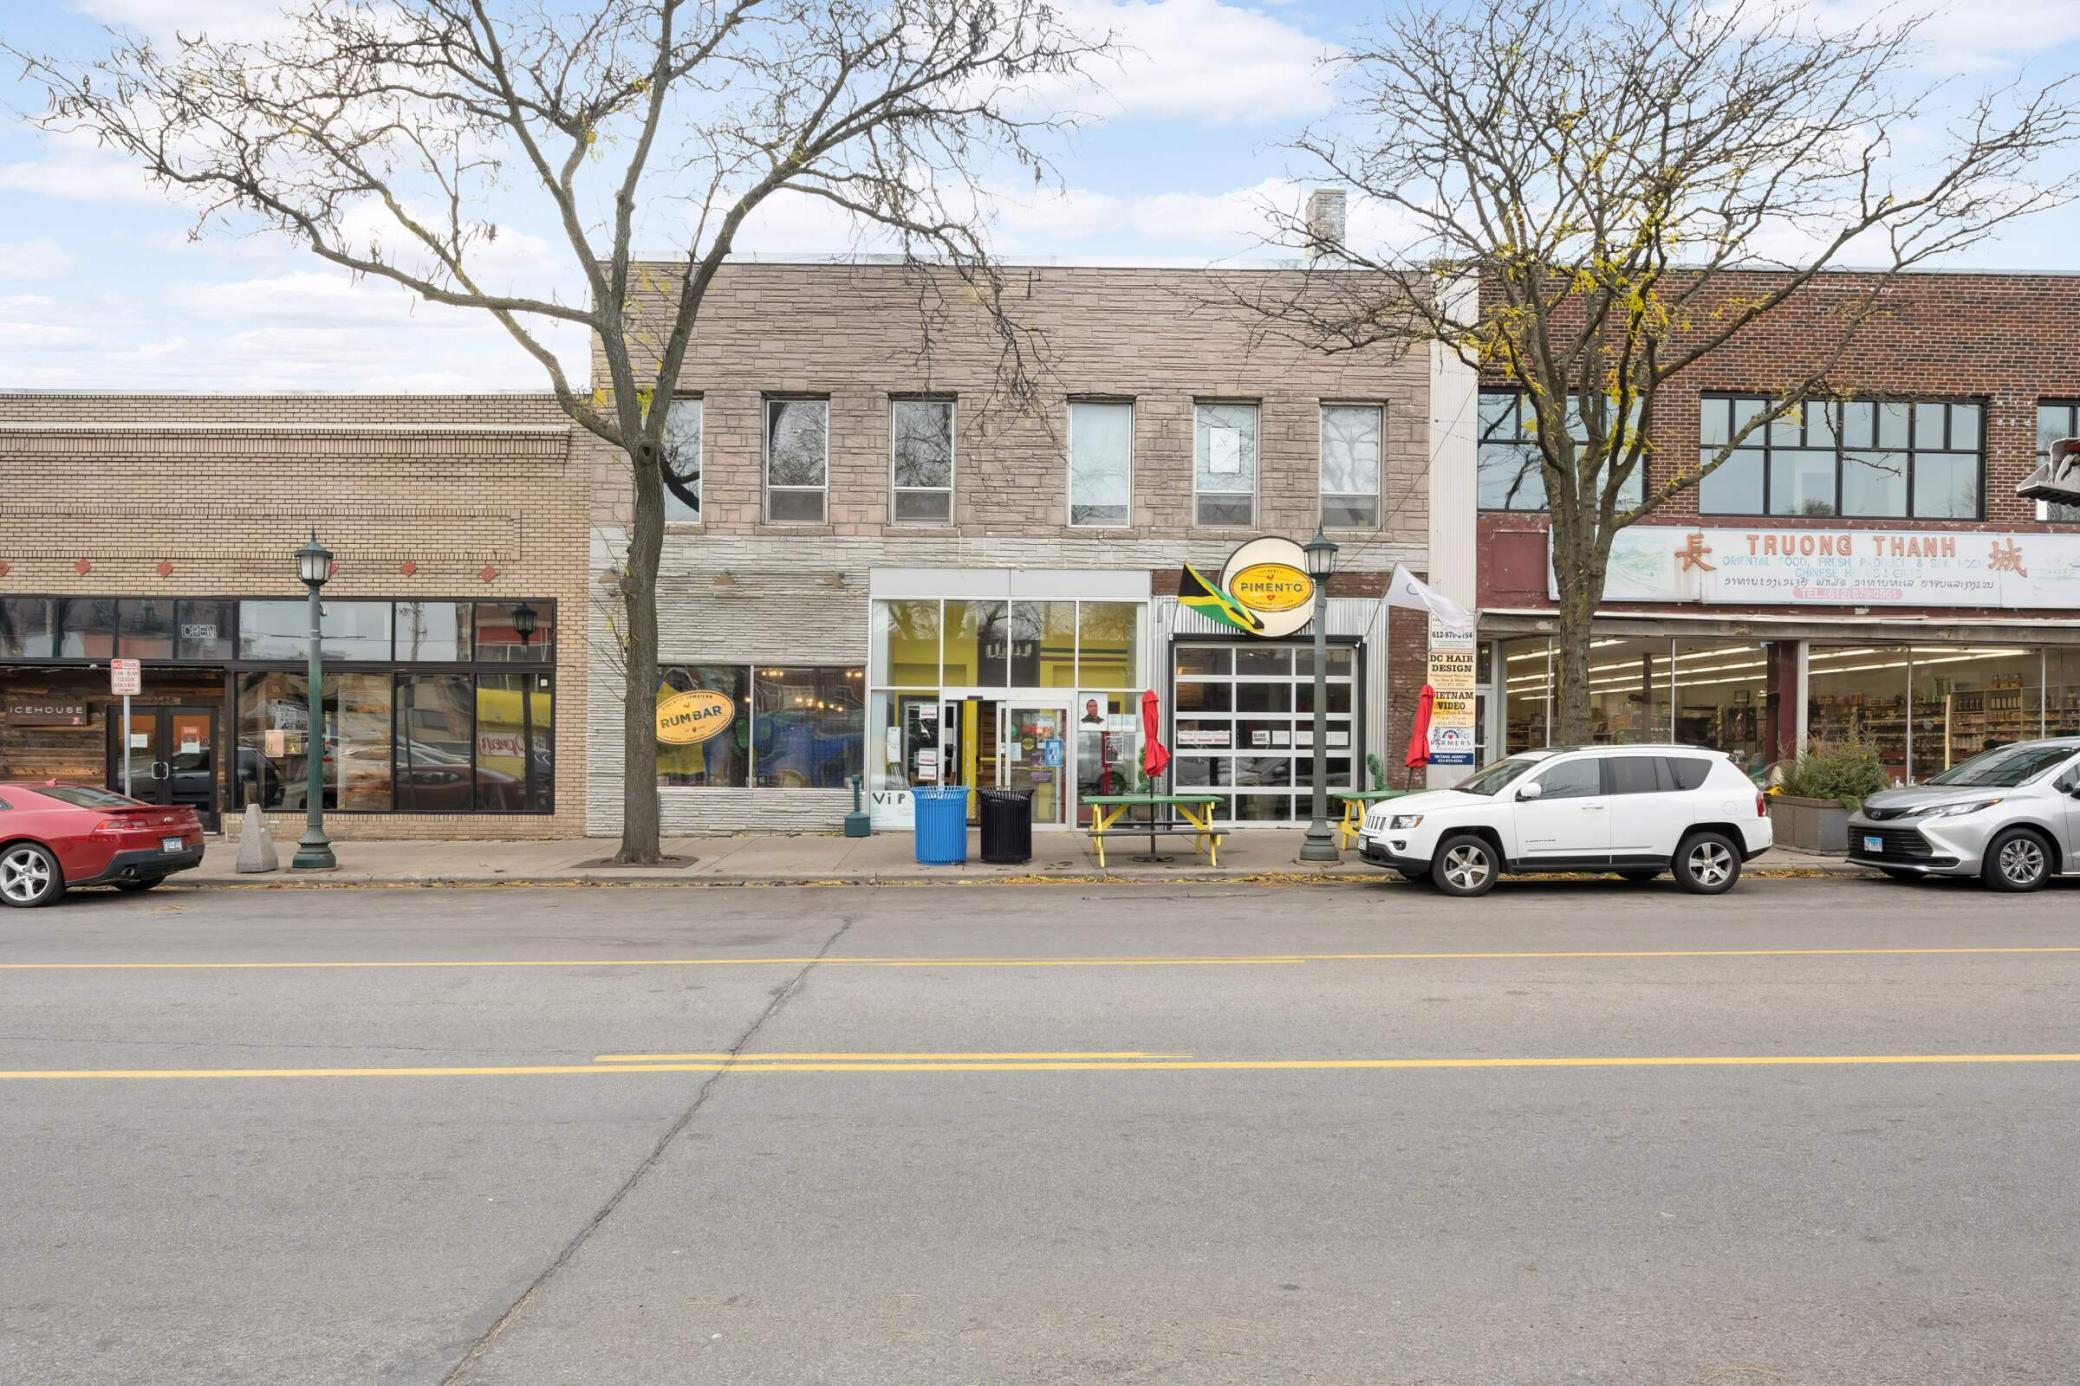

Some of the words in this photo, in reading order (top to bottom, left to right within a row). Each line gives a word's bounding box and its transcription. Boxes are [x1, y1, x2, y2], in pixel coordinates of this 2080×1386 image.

[1746, 534, 1852, 556] TRUONG
[1872, 535, 1956, 558] THANH
[1674, 533, 1717, 572] 長
[1722, 555, 1770, 567] ORIENTAL
[1240, 582, 1303, 592] PIMENTO
[183, 625, 215, 638] OPEN
[1430, 654, 1443, 663] DC
[1446, 655, 1473, 663] HAIR
[1432, 664, 1472, 672] DESIGN
[1434, 691, 1474, 700] IETNAM
[9, 706, 84, 714] ICEHOUSE
[1437, 701, 1466, 710] VIDEO
[660, 713, 692, 729] RUM
[692, 705, 722, 721] BAR
